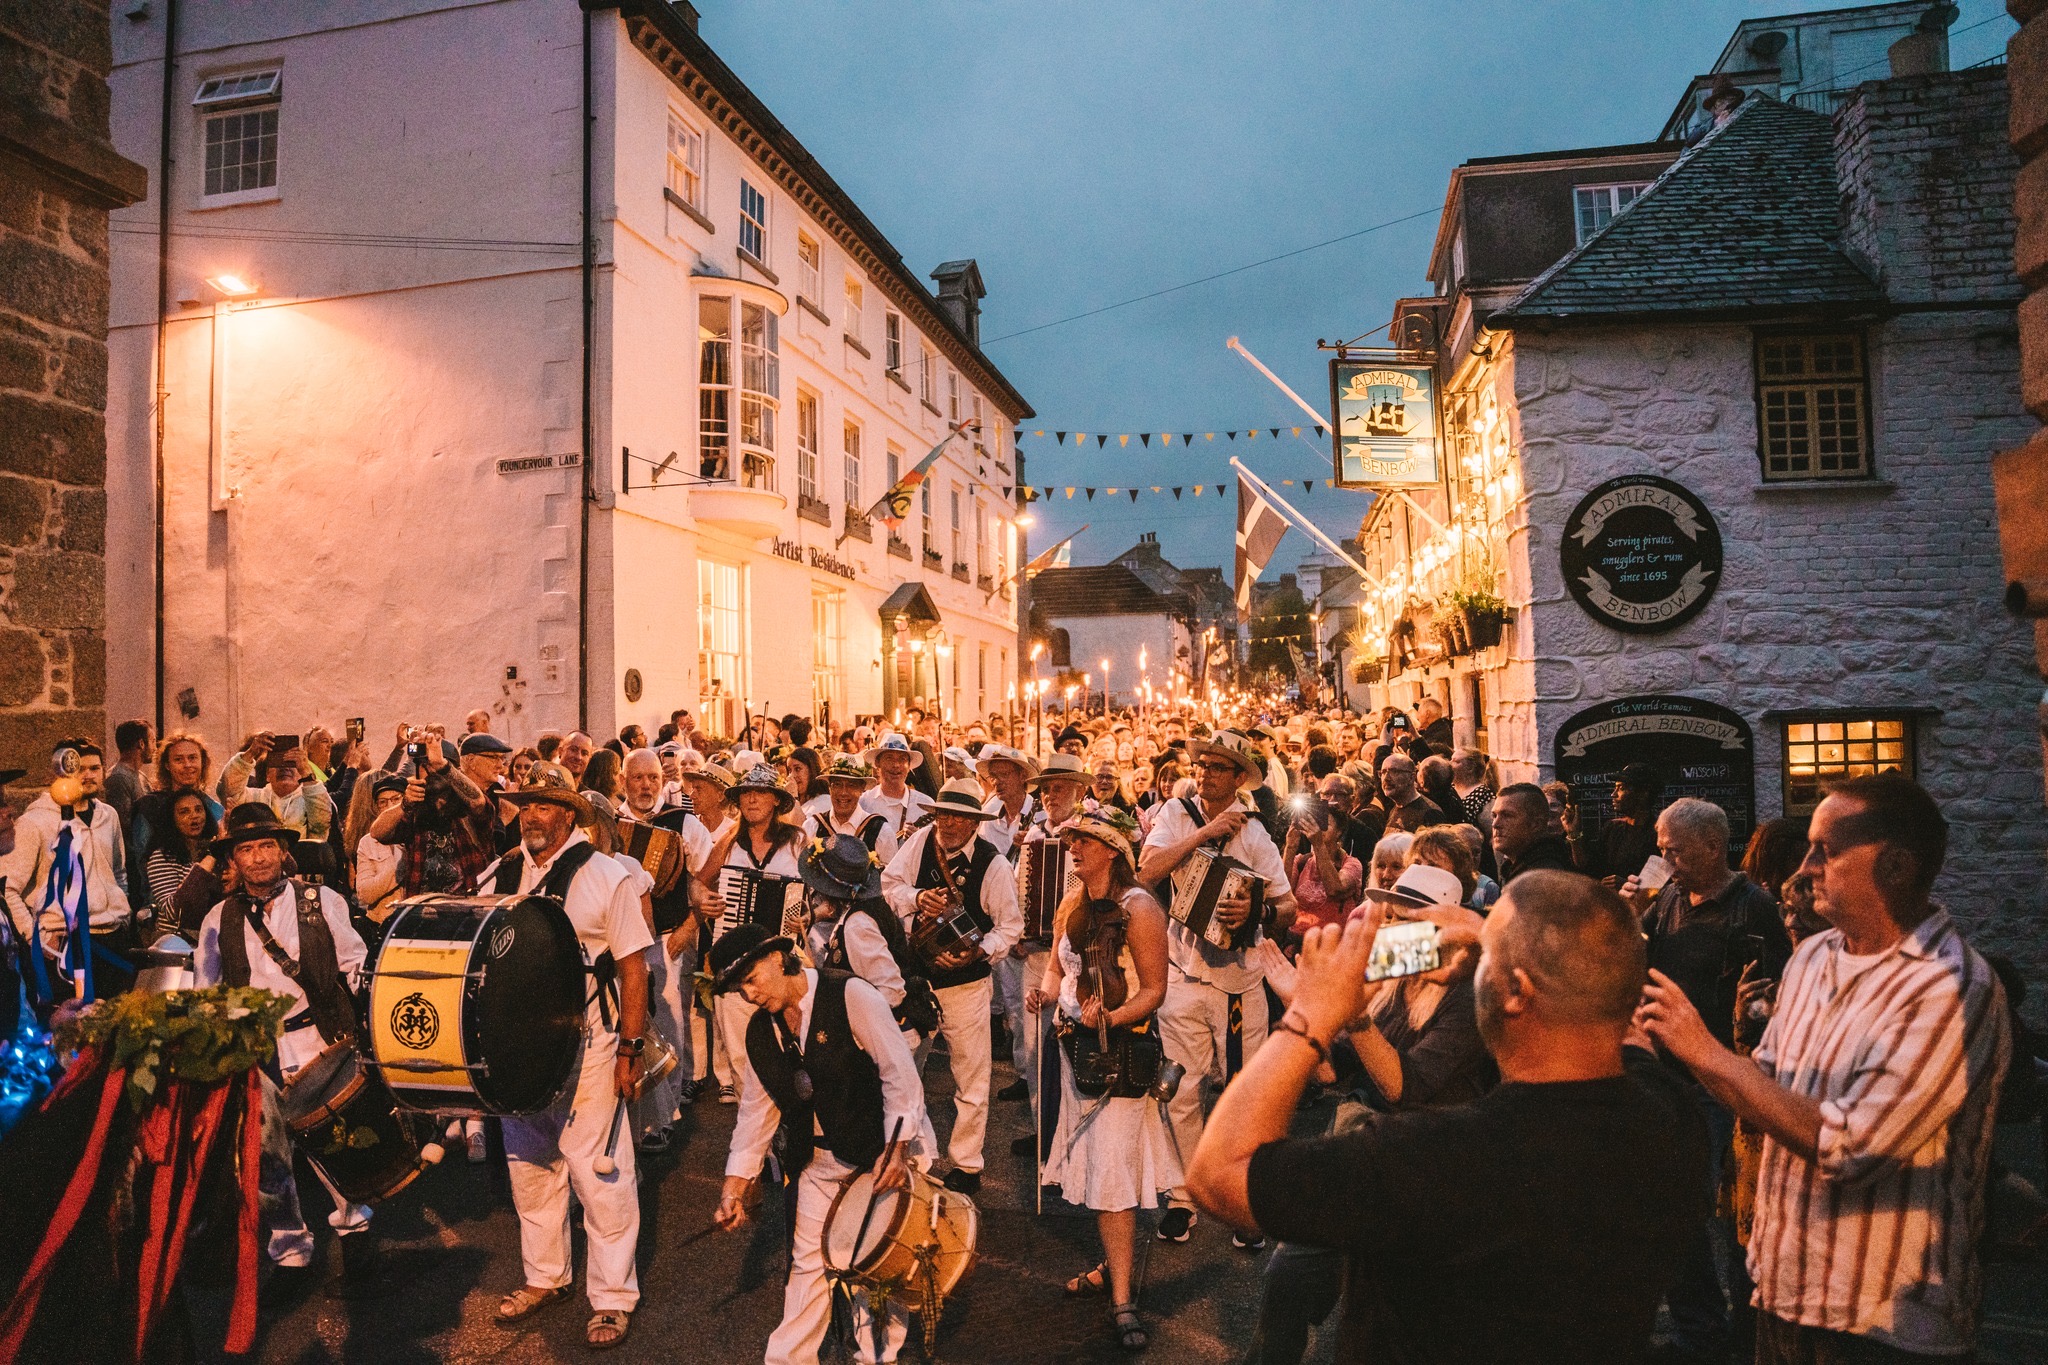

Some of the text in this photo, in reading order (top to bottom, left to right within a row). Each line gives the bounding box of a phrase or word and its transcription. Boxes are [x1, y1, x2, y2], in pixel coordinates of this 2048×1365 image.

[1355, 371, 1415, 390] ADMIRAL
[558, 454, 580, 466] LANE
[1361, 457, 1417, 475] BENBOW
[1591, 489, 1683, 524] ADMIRAL
[1607, 534, 1674, 551] Serving pirates,
[773, 535, 856, 580] Artist Residence
[1601, 551, 1683, 570] smugglers & rum
[1620, 571, 1668, 582] since 1695
[1603, 589, 1688, 620] BENBOW
[1611, 700, 1692, 714] The World Famous
[1575, 717, 1735, 746] ADMIRAL BENBOW
[1683, 765, 1726, 778] WASSON?
[749, 883, 758, 912] HOHNER
